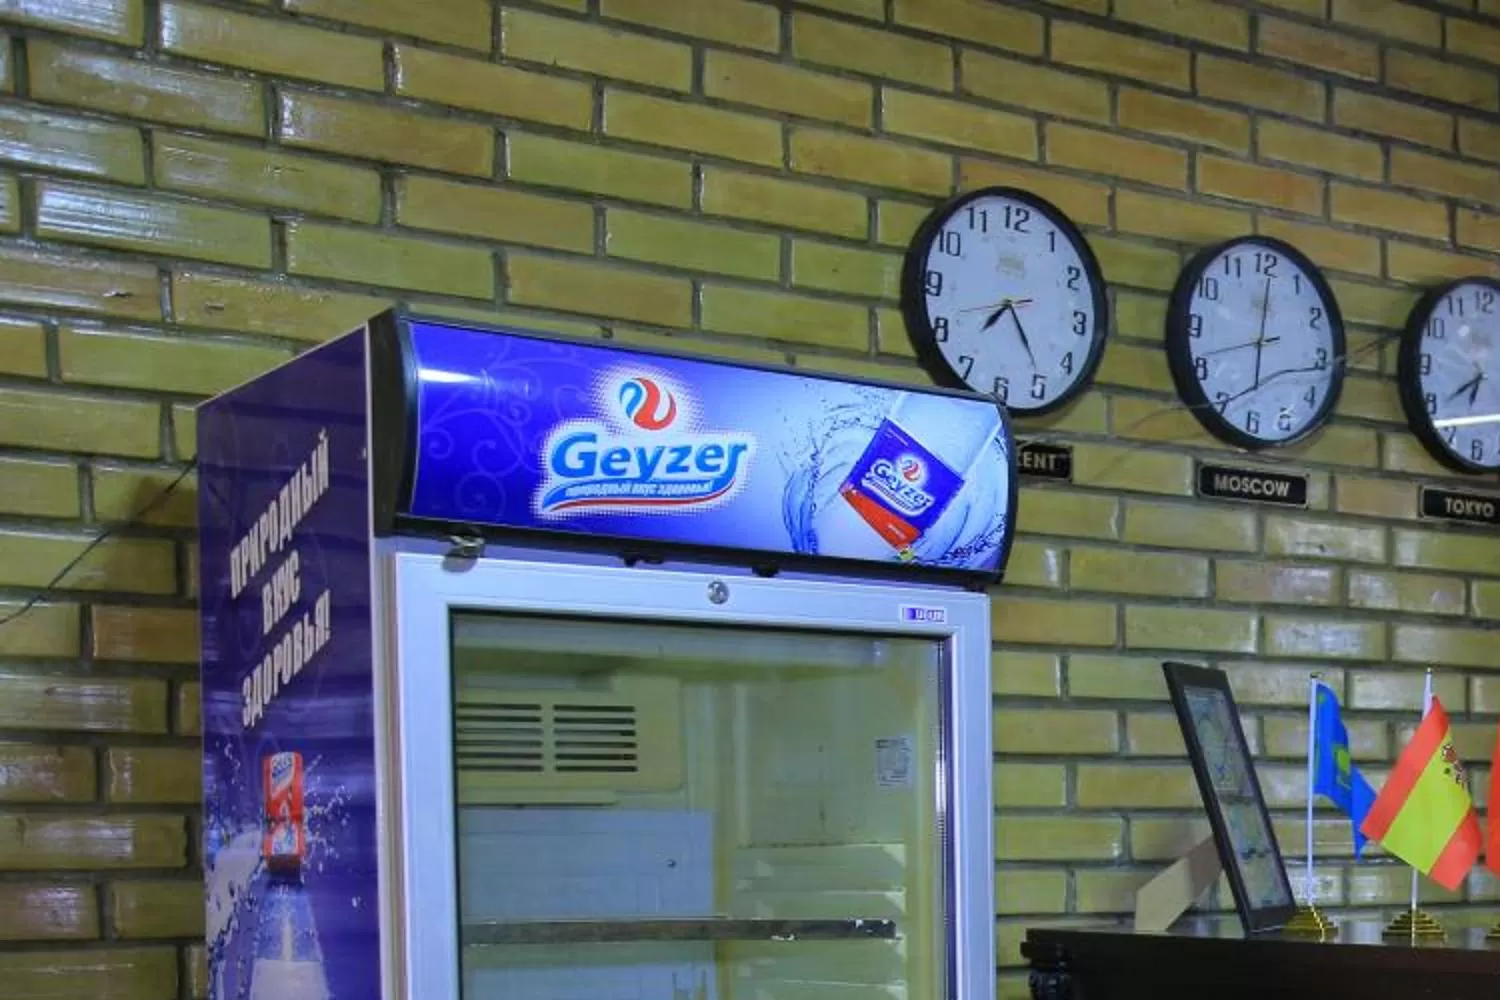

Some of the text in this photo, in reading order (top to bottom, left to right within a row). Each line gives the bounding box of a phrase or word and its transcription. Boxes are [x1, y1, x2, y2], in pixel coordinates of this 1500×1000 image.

[967, 206, 988, 233] 11
[1004, 205, 1030, 233] 12
[938, 229, 961, 256] 10
[1047, 231, 1055, 253] 1
[1067, 265, 1080, 290] 2
[1224, 255, 1241, 279] 11
[1254, 253, 1277, 277] 12
[926, 270, 943, 297] 9
[1293, 274, 1300, 297] 1
[1448, 295, 1464, 317] 11
[1474, 290, 1494, 314] 12
[934, 317, 949, 342] 8
[1073, 311, 1087, 336] 3
[1189, 314, 1203, 338] 9
[1309, 306, 1321, 331] 2
[959, 356, 975, 381] 7
[1060, 352, 1073, 375] 4
[1195, 356, 1208, 381] 8
[1315, 347, 1327, 370] 3
[994, 376, 1009, 402] 6
[1031, 374, 1047, 400] 5
[1304, 385, 1315, 409] 4
[1246, 410, 1260, 434] 6
[551, 431, 748, 484] Geyzer
[1471, 439, 1483, 461] 6
[872, 461, 933, 507] Geyzer
[1214, 473, 1291, 497] MOSCOW
[230, 427, 329, 599] ПРИРОДНЫЙ
[1444, 497, 1495, 518] TOKYO
[262, 549, 300, 635] ВКУС
[242, 589, 331, 727] ЗДОРОВЬЯ!
